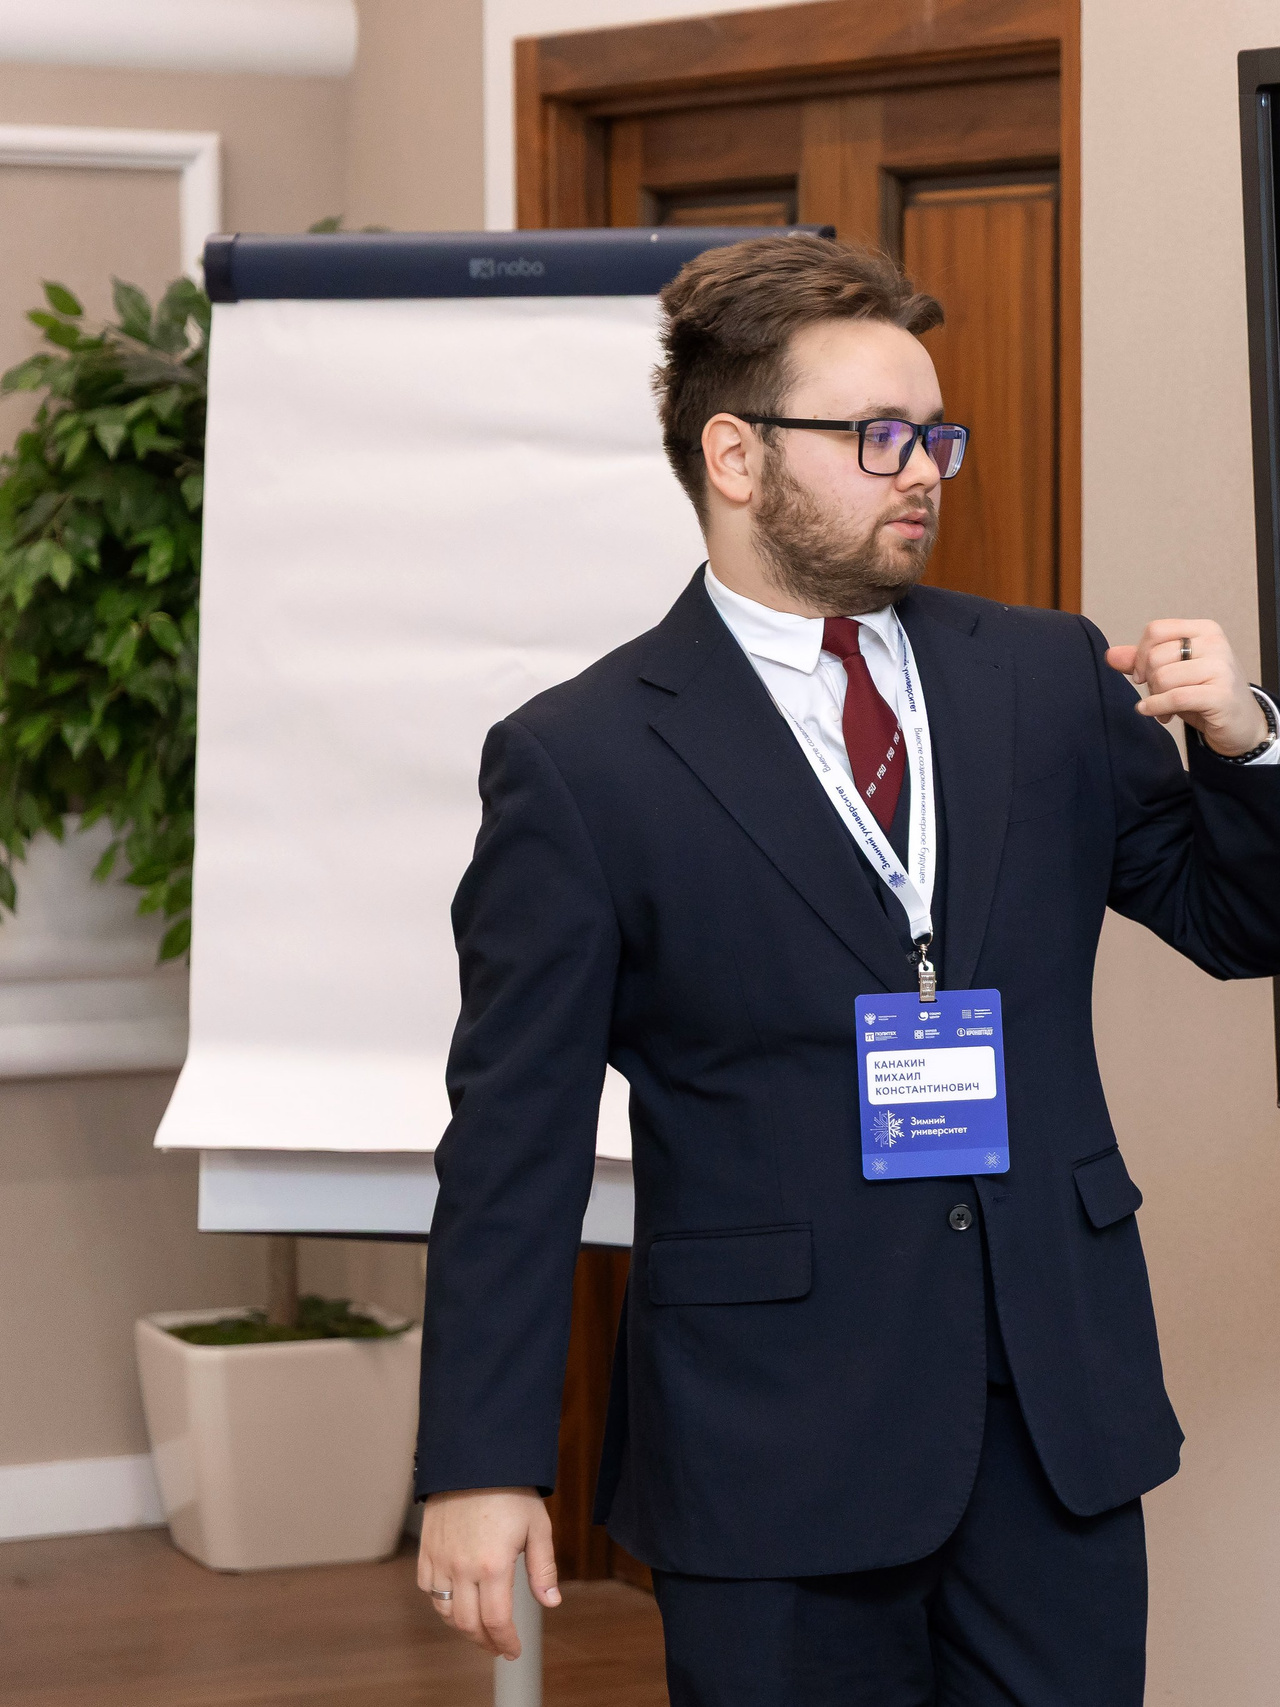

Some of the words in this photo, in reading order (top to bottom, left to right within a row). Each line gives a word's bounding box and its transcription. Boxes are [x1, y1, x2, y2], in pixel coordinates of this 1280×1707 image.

[902, 666, 917, 713] университет
[914, 728, 923, 755] Вместе
[812, 747, 831, 773] Вместе
[835, 785, 873, 837] университет
[918, 792, 927, 846] инженерное
[865, 837, 891, 870] Зимний
[917, 847, 930, 884] будущее
[874, 1058, 926, 1070] КАНАКИН
[875, 1072, 921, 1082] МИХАИЛ
[875, 1082, 980, 1096] КОНСТАНТИНОВИЧ
[910, 1115, 946, 1126] Зимний
[910, 1126, 968, 1139] университет
